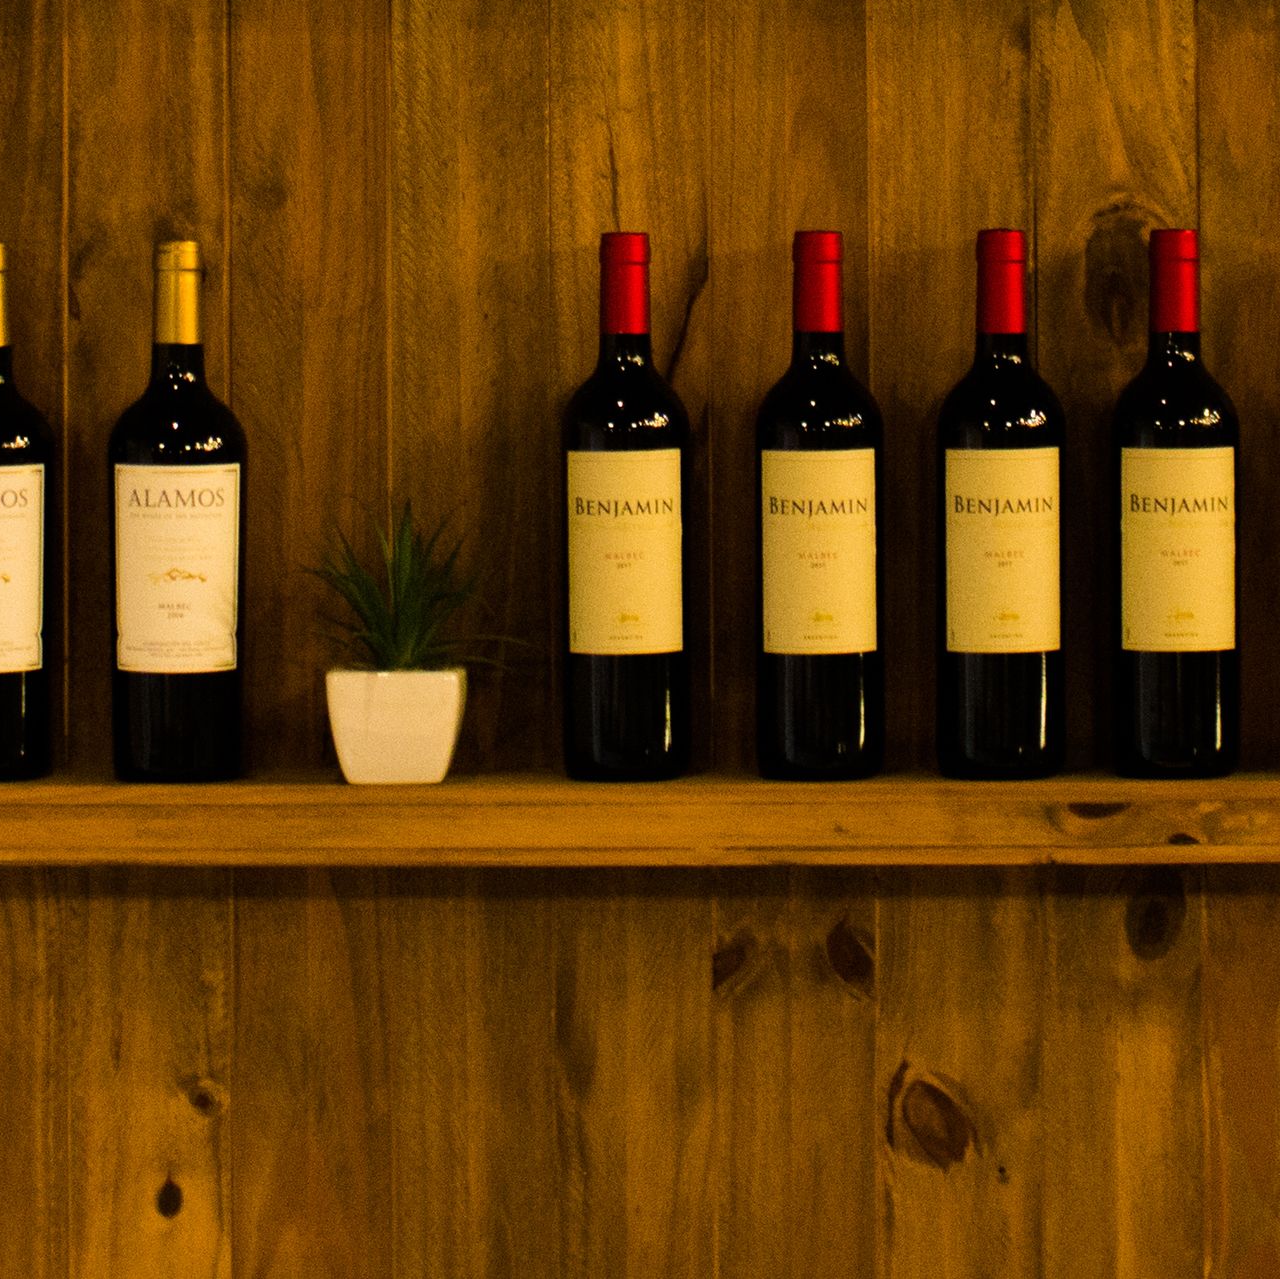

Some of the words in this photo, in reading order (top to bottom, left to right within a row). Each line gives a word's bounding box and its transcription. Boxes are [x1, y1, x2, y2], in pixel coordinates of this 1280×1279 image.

[128, 488, 225, 508] ALAMOS
[574, 496, 673, 518] BENJAMIN
[769, 496, 868, 518] BENJAMIN
[954, 495, 1054, 516] BENJAMIN
[1130, 493, 1229, 516] BENJAMIN
